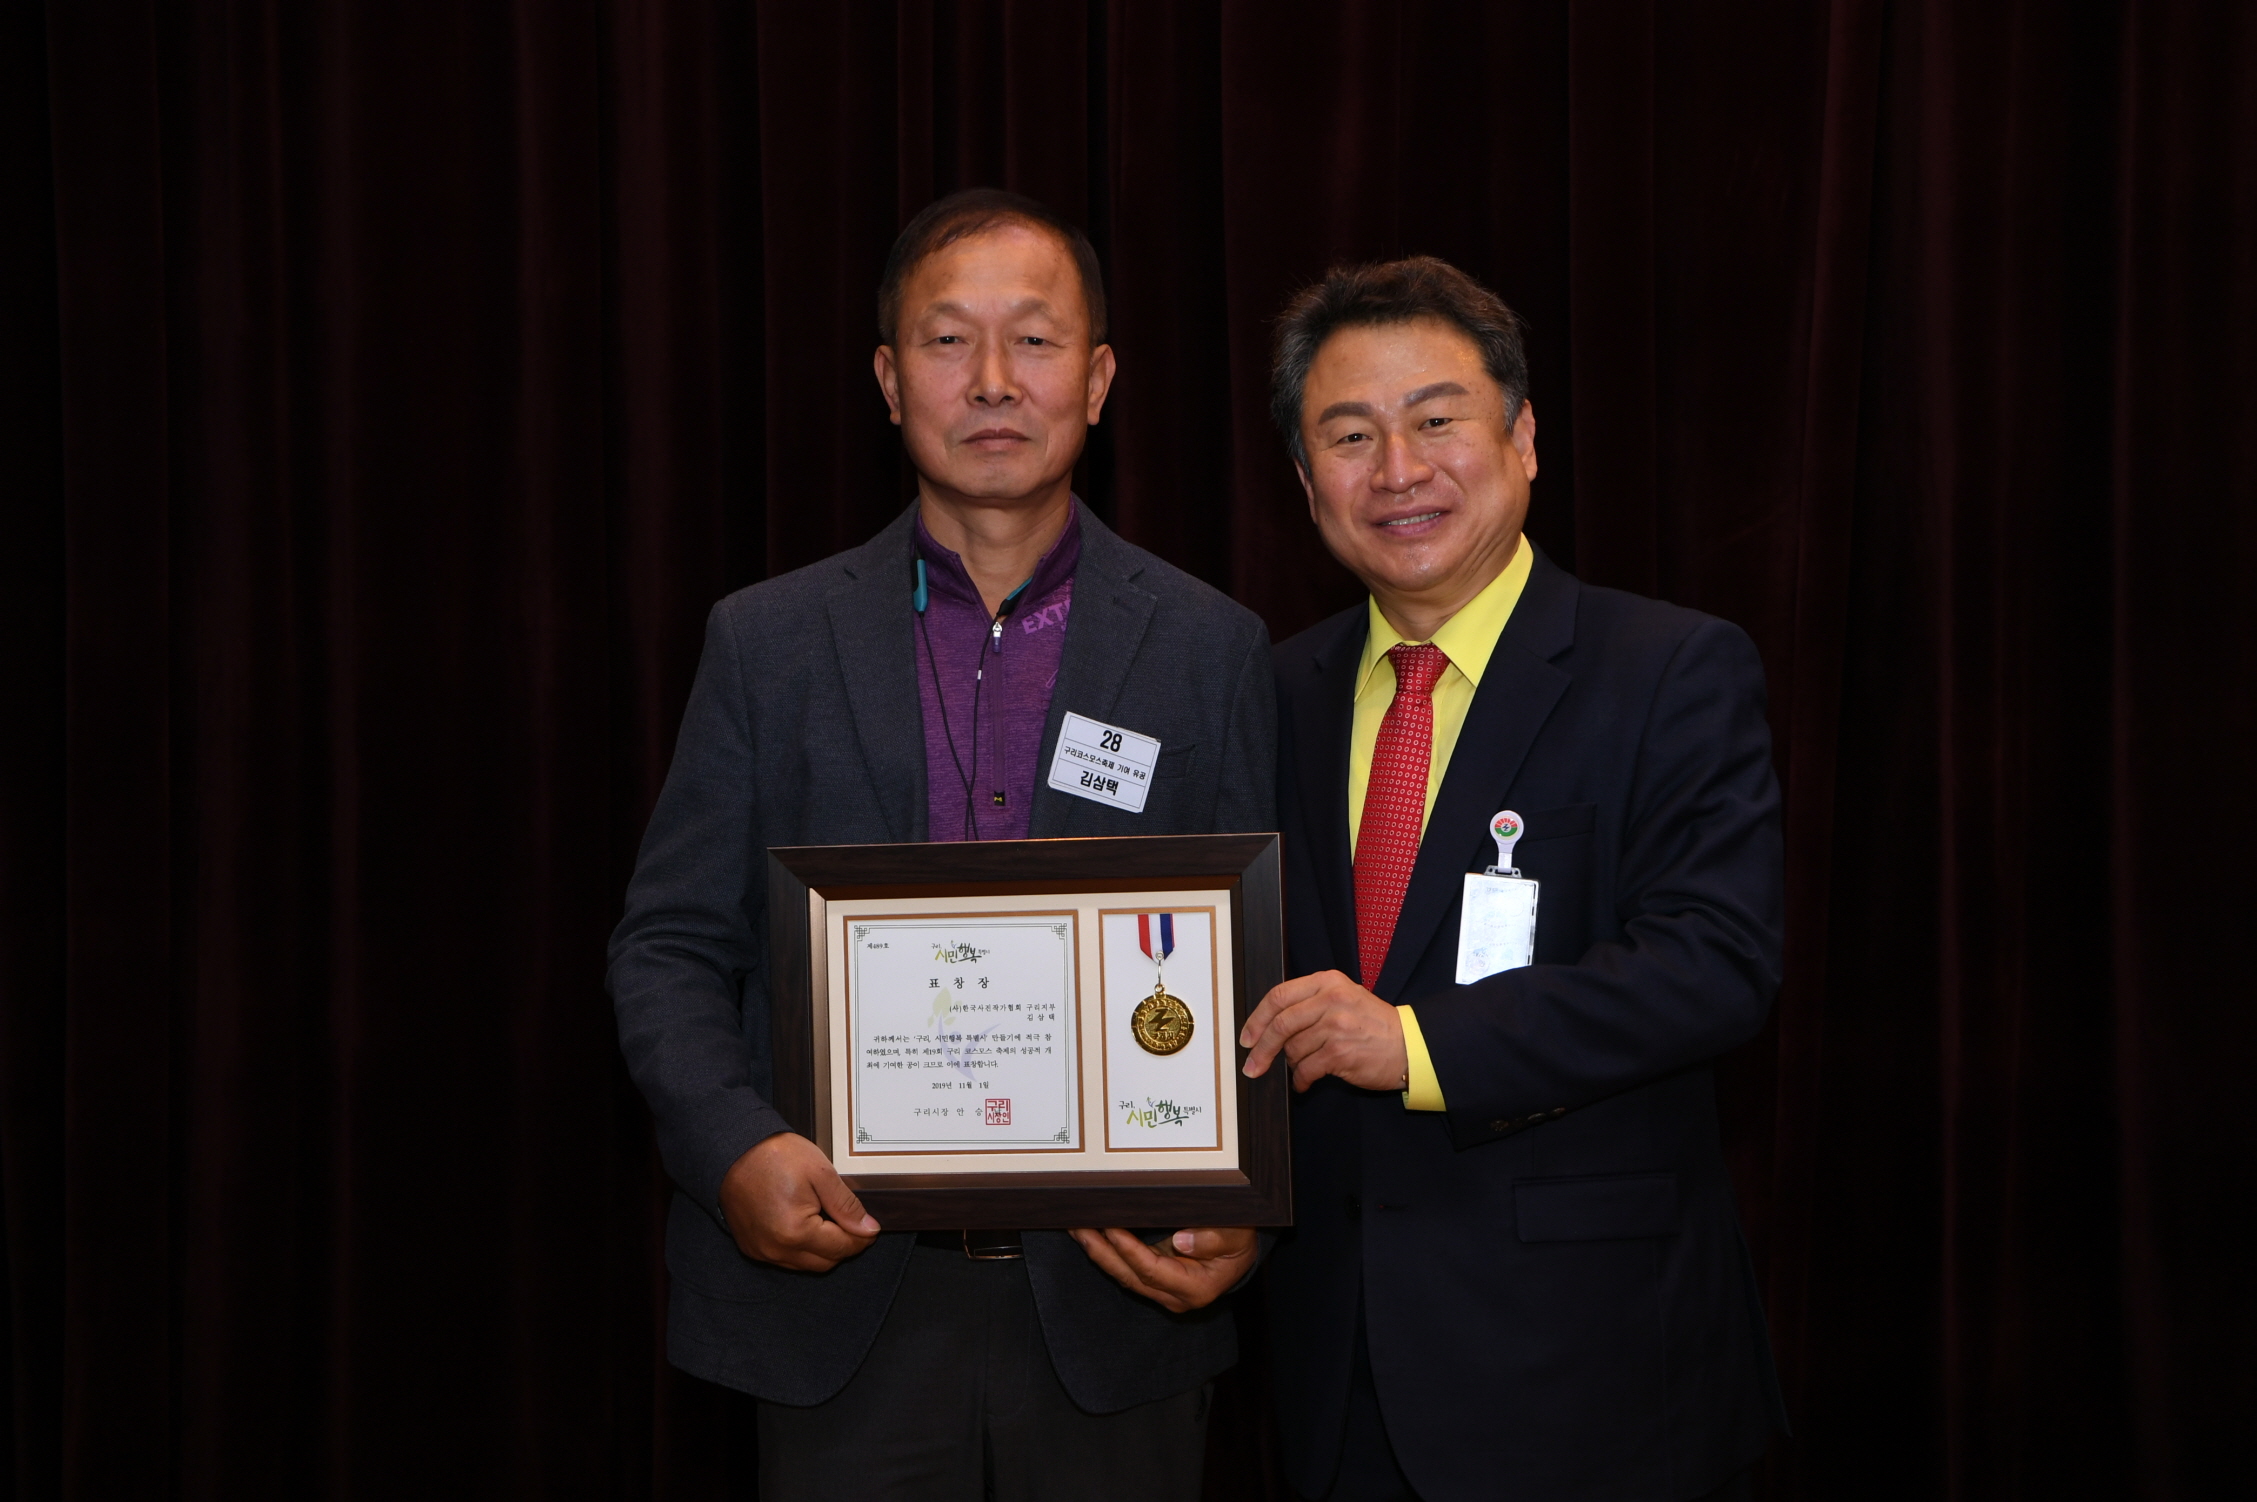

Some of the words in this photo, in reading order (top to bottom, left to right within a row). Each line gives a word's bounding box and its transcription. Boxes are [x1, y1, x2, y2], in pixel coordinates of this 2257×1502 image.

[1100, 730, 1122, 752] 28
[1064, 746, 1115, 770] 구리코스모스축제
[1117, 764, 1130, 775] 기여
[1132, 769, 1146, 780] 유공
[1080, 770, 1119, 796] 김삼택
[1026, 1003, 1056, 1012] 구리지부
[946, 1047, 961, 1055] 구리
[932, 1081, 953, 1090] 2019년
[958, 1081, 973, 1090] 11월
[979, 1081, 989, 1089] 1일
